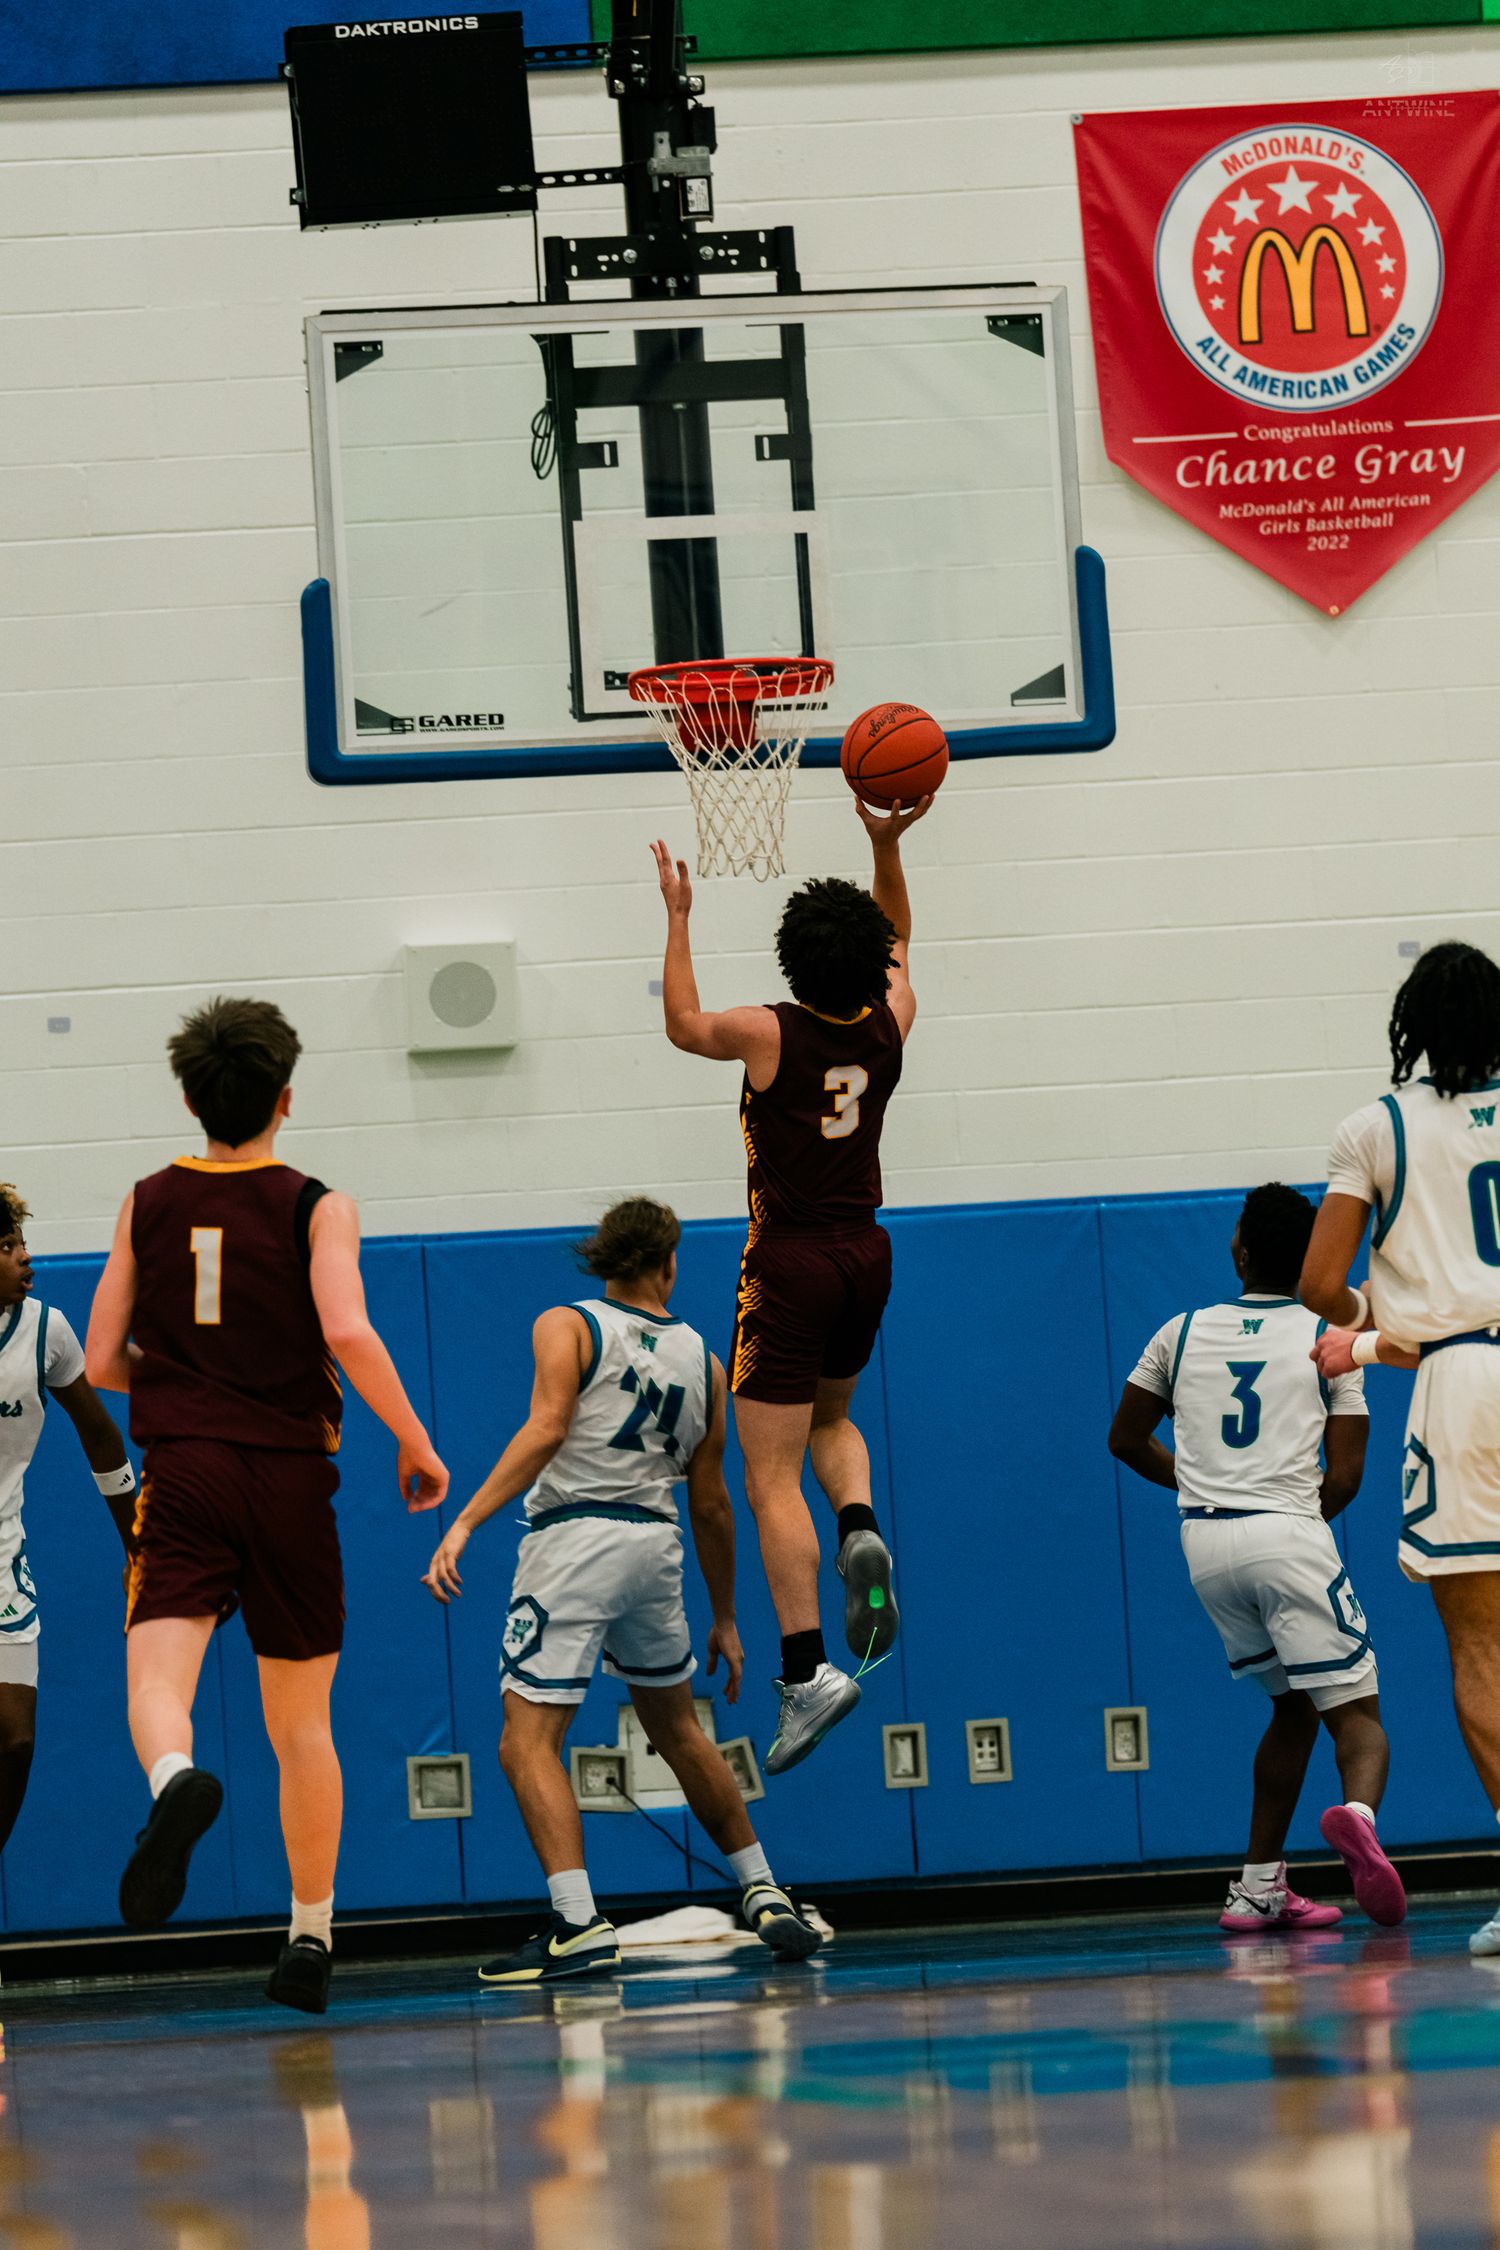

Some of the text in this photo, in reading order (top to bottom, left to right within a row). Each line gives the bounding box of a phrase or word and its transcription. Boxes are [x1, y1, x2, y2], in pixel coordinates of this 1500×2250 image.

[335, 16, 479, 39] DAKTRONICS
[1196, 323, 1416, 399] ALL AMERICAN GAMES
[1243, 419, 1394, 444] Congratulations
[1175, 444, 1466, 489] Chance Gray
[1219, 493, 1431, 520] McDonald's All American
[1259, 514, 1394, 536] Girls Basketball
[1307, 535, 1350, 551] 2022
[419, 713, 504, 728] GARED
[820, 1064, 869, 1140] 3
[190, 1226, 223, 1325] 1
[1221, 1360, 1268, 1450] 3
